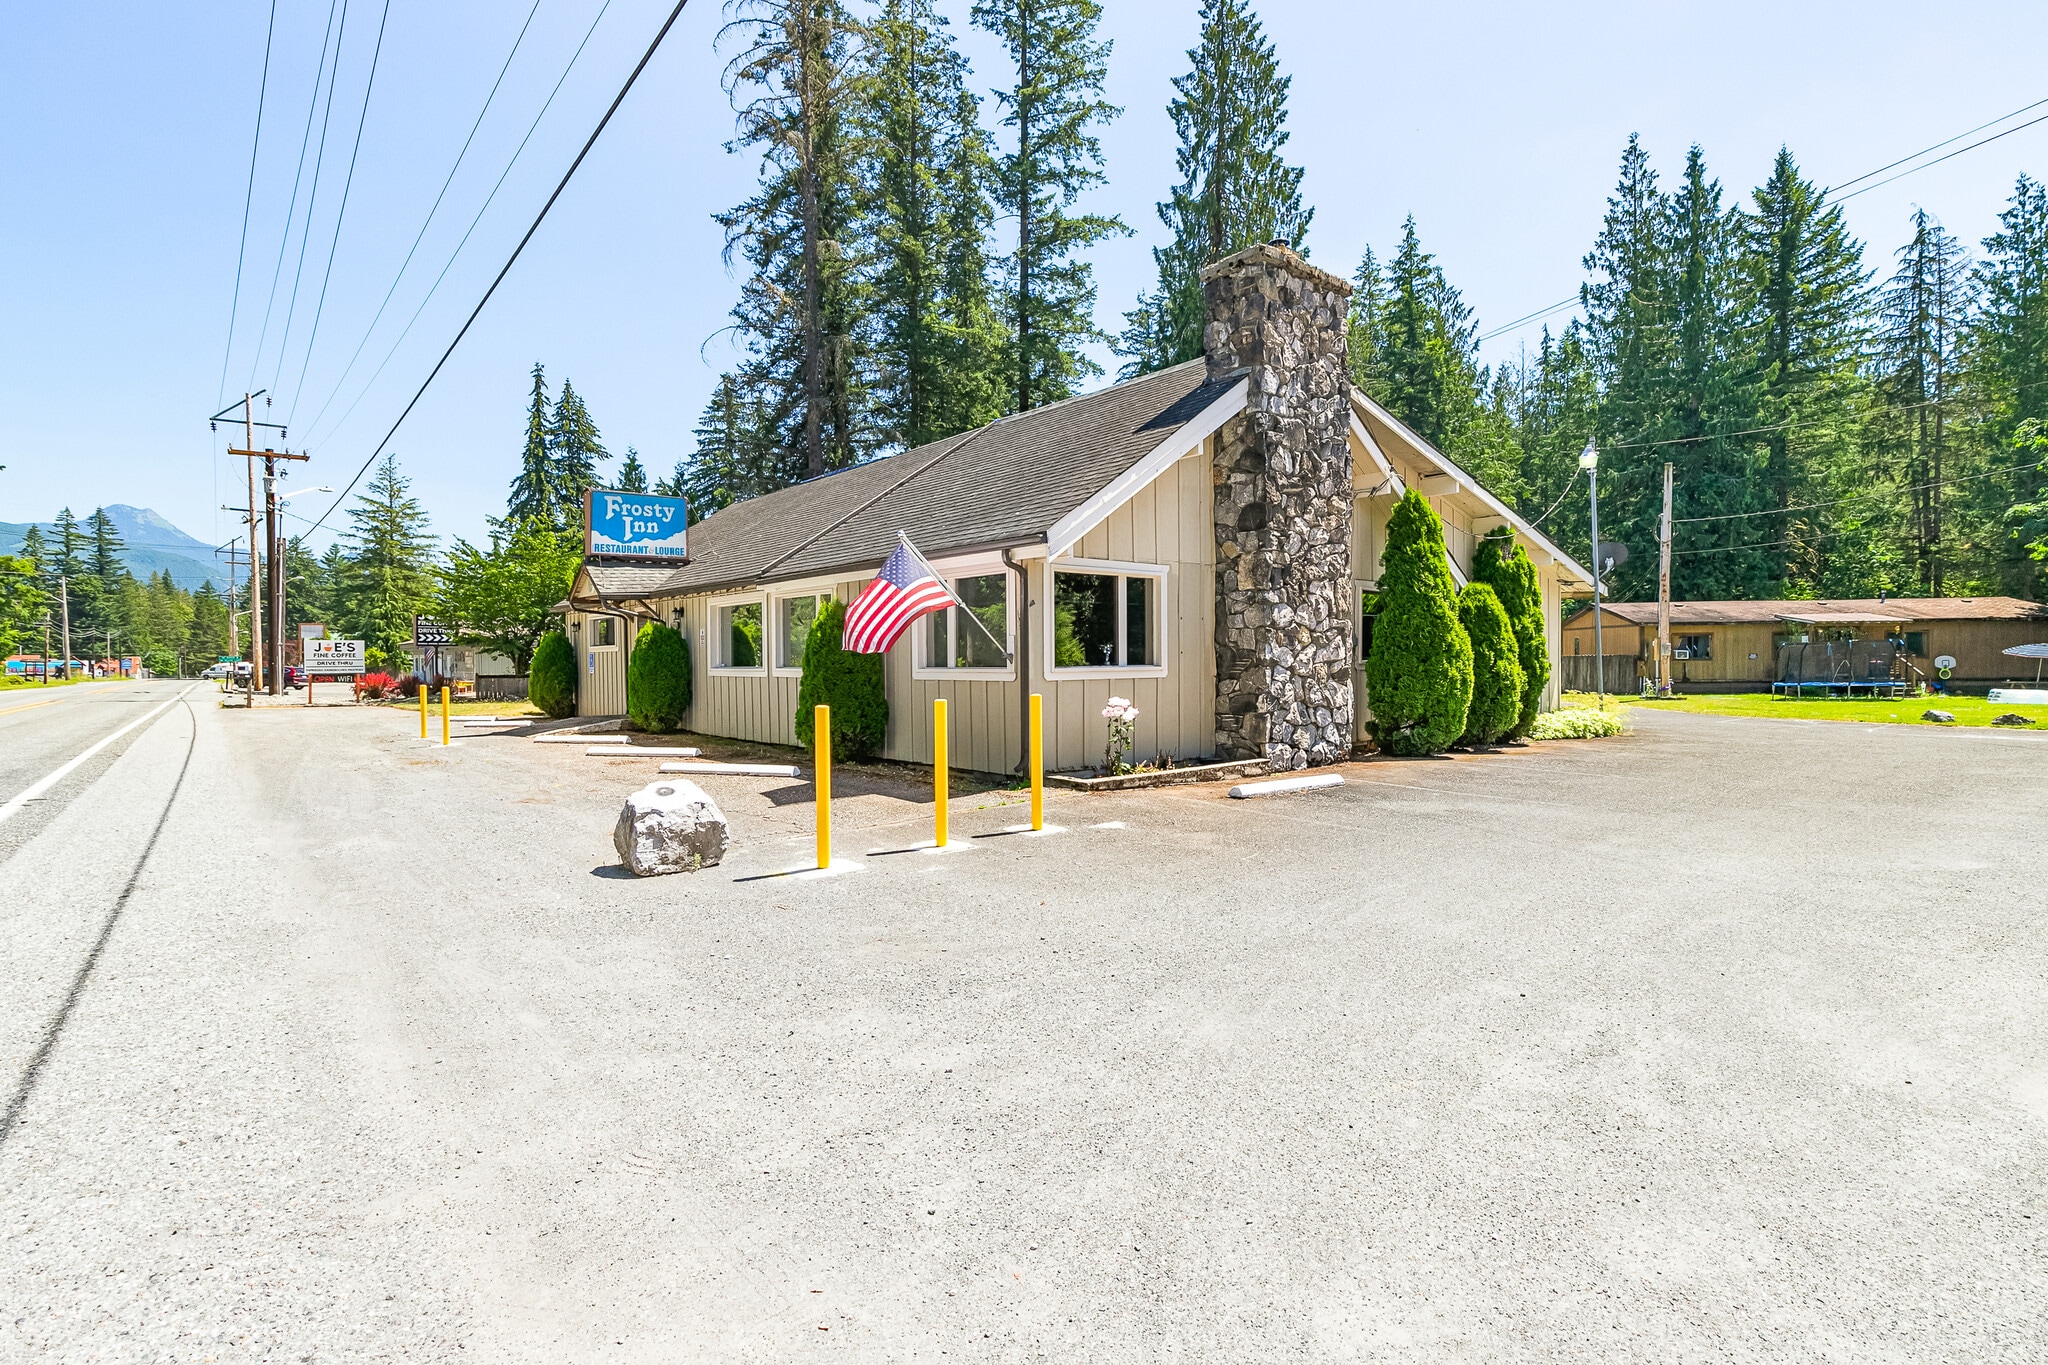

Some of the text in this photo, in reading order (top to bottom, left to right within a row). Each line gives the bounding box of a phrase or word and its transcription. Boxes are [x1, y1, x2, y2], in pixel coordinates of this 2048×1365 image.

[604, 496, 675, 522] Frosty
[622, 516, 659, 541] Inn
[594, 544, 648, 554] RESTAURANT
[655, 546, 684, 555] LOUNGE
